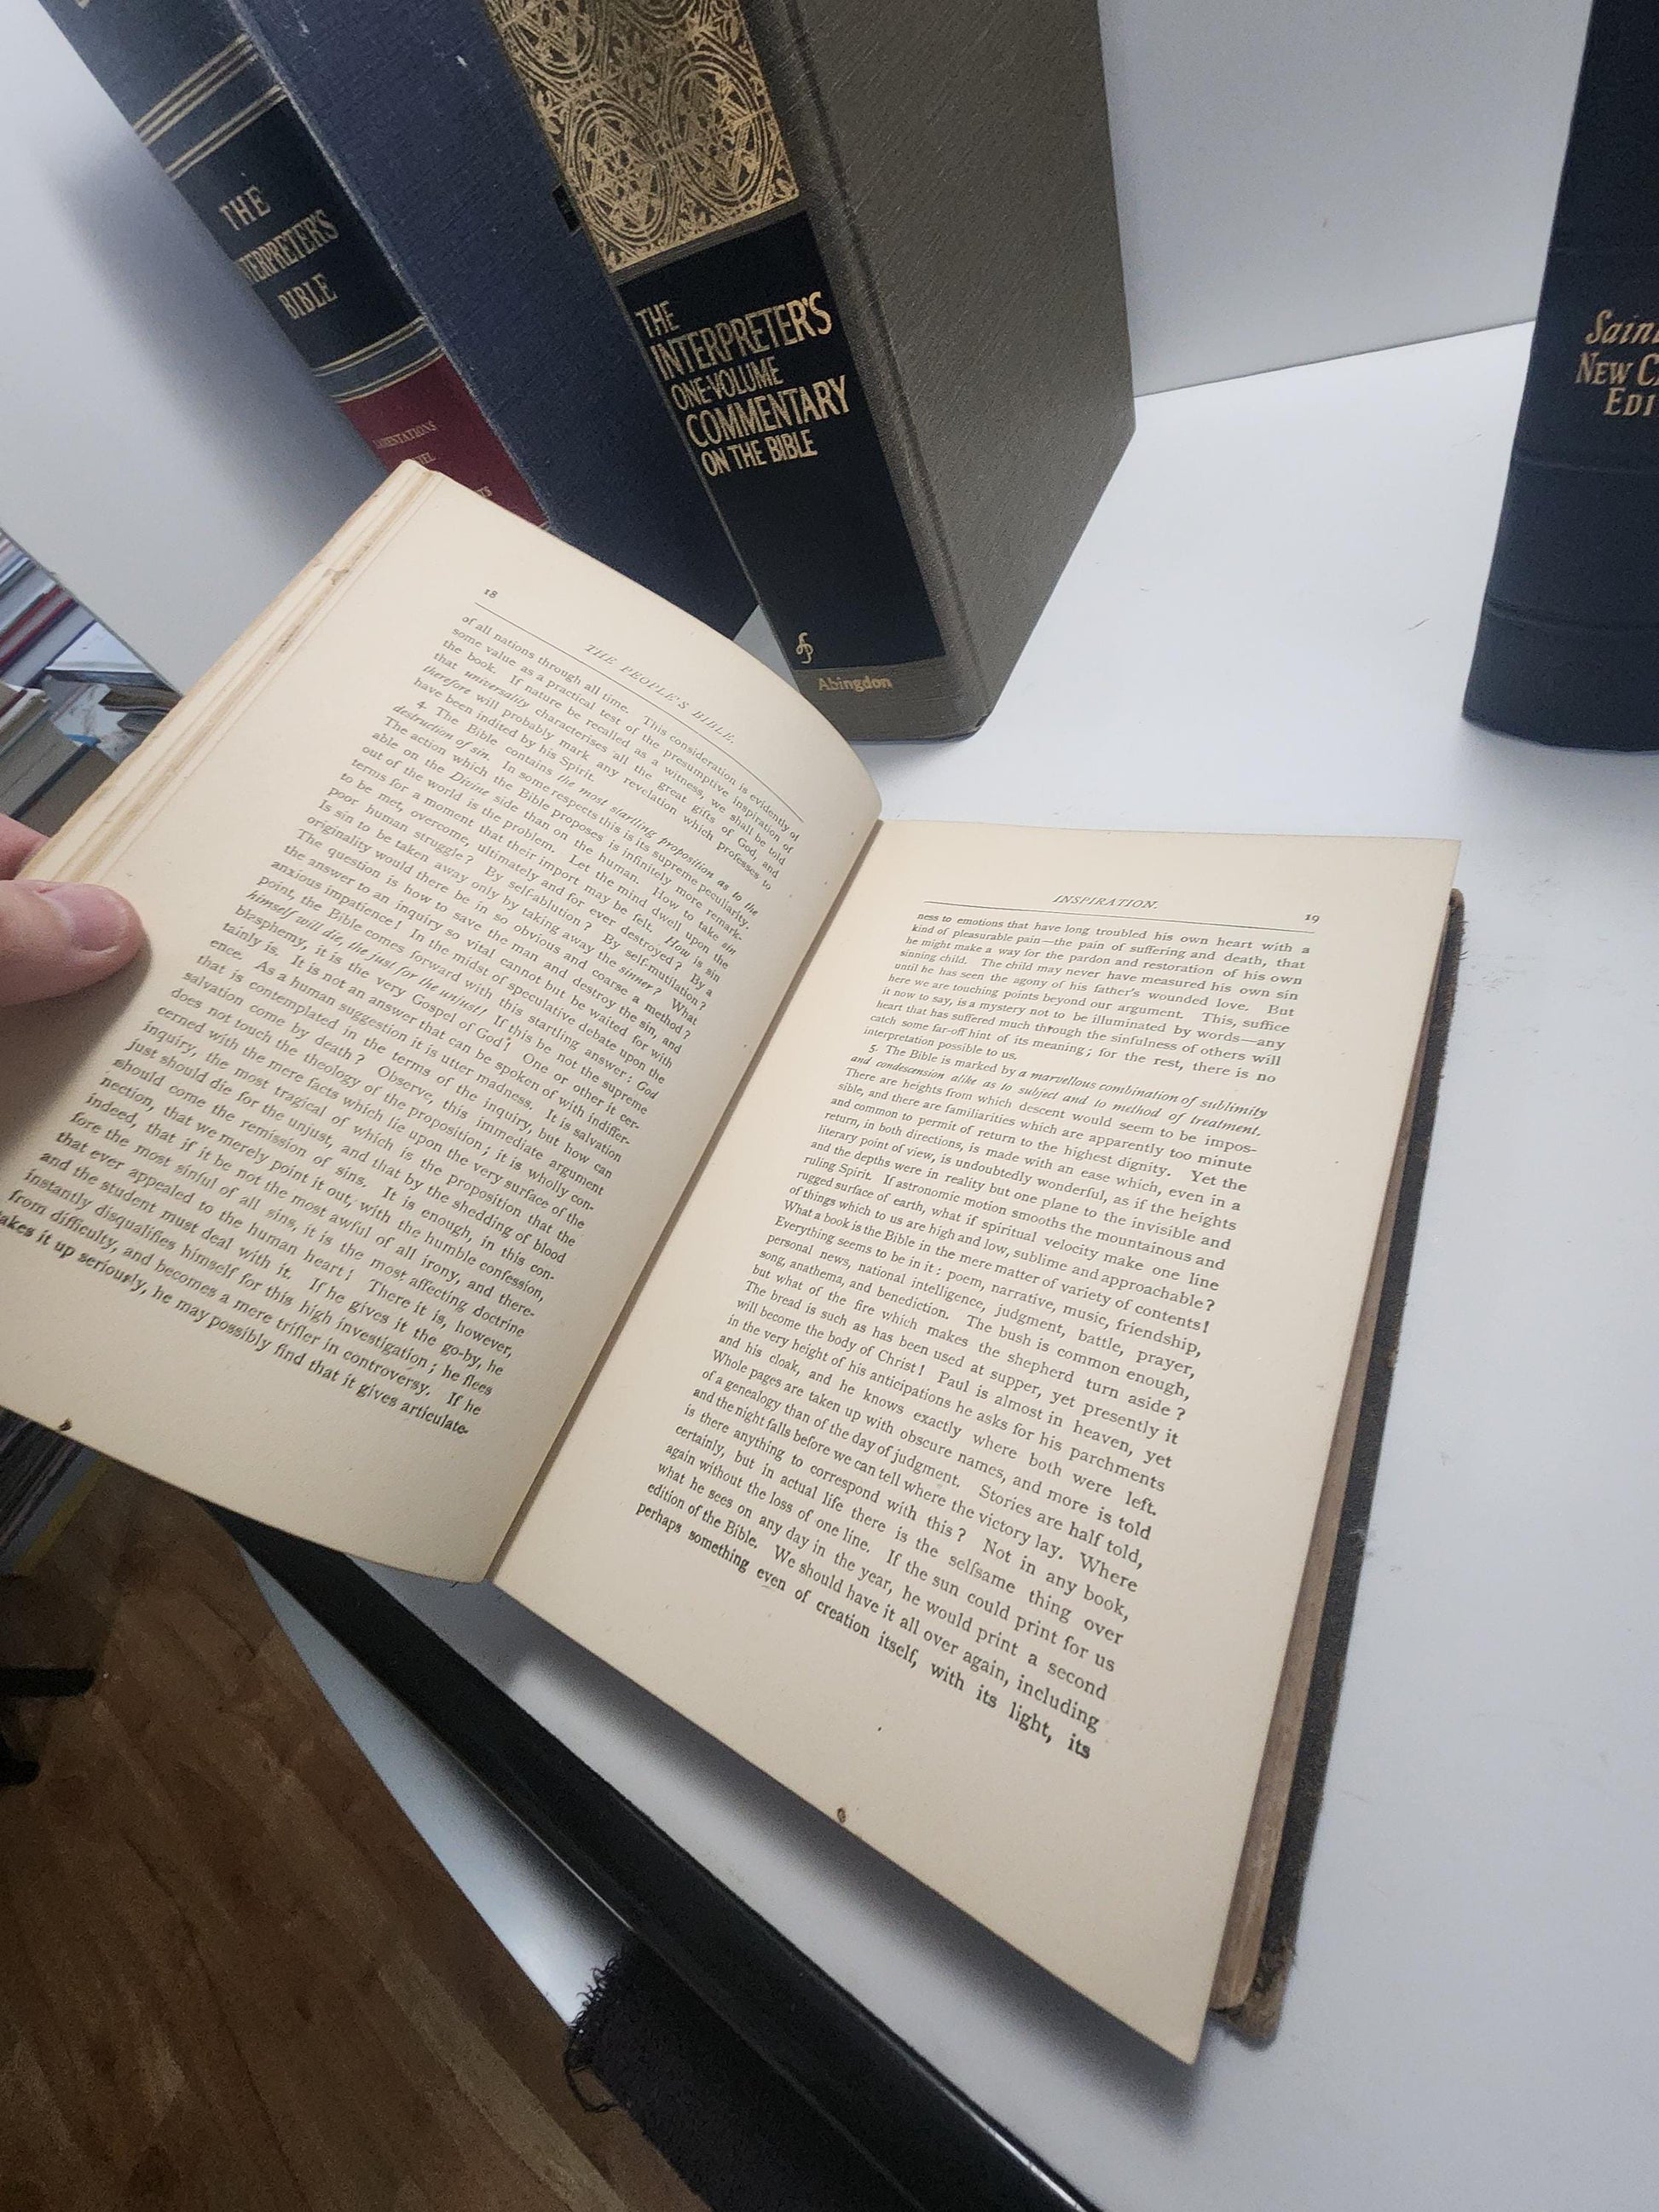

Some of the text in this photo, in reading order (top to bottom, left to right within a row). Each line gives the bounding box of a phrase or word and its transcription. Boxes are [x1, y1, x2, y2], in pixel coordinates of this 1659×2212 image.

[218, 185, 271, 230] THE
[234, 210, 339, 282] TERPRETER'S
[278, 273, 338, 320] BIBLE
[634, 300, 680, 338] THE
[650, 292, 833, 380] INTERPRETER'S
[670, 355, 784, 411] ONE-VOLUME
[1638, 353, 1659, 386] C
[685, 374, 850, 448] COMMENTARY
[1604, 387, 1656, 416] EDI
[701, 429, 818, 477] ON THE BIBLE
[483, 588, 499, 599] 18
[584, 644, 617, 665] THE
[619, 666, 690, 710] PEOPLE'S
[818, 675, 893, 692] Abingdon
[452, 628, 482, 648] some
[487, 646, 516, 667] value
[520, 667, 534, 676] as
[545, 680, 596, 710] practical
[600, 709, 621, 725] test
[626, 725, 640, 735] of
[642, 734, 660, 748] the
[662, 749, 729, 797] presumptive
[732, 796, 780, 842] inspiration
[783, 844, 794, 853] of
[297, 829, 322, 848] The
[327, 848, 381, 878] question
[385, 875, 398, 887] is
[403, 883, 432, 903] how
[435, 902, 448, 912] to
[453, 912, 482, 931] save
[487, 929, 508, 944] the
[511, 943, 539, 962] man
[543, 962, 569, 979] and
[572, 977, 617, 1009] destroy
[619, 1006, 638, 1022] the
[662, 1037, 682, 1054] and
[957, 918, 1003, 927] emotions
[1007, 921, 1028, 929] that
[1033, 921, 1061, 932] have
[1064, 924, 1090, 936] long
[1096, 928, 1147, 939] troubled
[1153, 932, 1173, 941] his
[1180, 936, 1208, 944] own
[1216, 937, 1252, 949] heart
[1262, 942, 1292, 952] with
[1304, 914, 1320, 924] 19
[905, 936, 918, 944] he
[921, 939, 951, 950] might
[954, 944, 983, 952] make
[999, 949, 1020, 958] way
[1024, 949, 1041, 957] for
[1045, 950, 1064, 960] the
[1068, 955, 1110, 964] pardon
[1114, 958, 1139, 967] and
[1142, 962, 1214, 975] restoration
[1223, 968, 1240, 978] of
[1243, 970, 1265, 981] his
[1270, 975, 1302, 985] own
[765, 1234, 814, 1255] personal
[858, 1263, 906, 1285] national
[8, 1189, 48, 1216] from
[121, 1247, 155, 1266] and
[153, 1258, 218, 1297] becomes
[218, 1294, 230, 1304] a
[232, 1299, 273, 1324] mere
[275, 1318, 321, 1345] trifler
[321, 1337, 339, 1355] in
[446, 1391, 465, 1407] If
[463, 1398, 482, 1415] he
[849, 1280, 873, 1293] and
[967, 1314, 992, 1333] The
[998, 1325, 1032, 1346] bush
[1036, 1337, 1049, 1352] is
[1057, 1349, 1120, 1376] common
[745, 1280, 766, 1297] The
[770, 1290, 803, 1310] bread
[805, 1302, 817, 1315] is
[820, 1311, 847, 1326] such
[853, 1323, 867, 1333] as
[871, 1325, 893, 1343] has
[899, 1335, 928, 1355] been
[934, 1350, 965, 1367] used
[970, 1364, 985, 1376] at
[1049, 1391, 1076, 1407] yet
[1081, 1403, 1160, 1440] presently
[1165, 1428, 1178, 1445] it
[734, 1449, 755, 1470] but
[761, 1463, 774, 1479] in
[780, 1476, 818, 1499] actual
[821, 1491, 843, 1512] life
[851, 1506, 886, 1533] there
[894, 1526, 908, 1543] is
[915, 1537, 939, 1557] the
[948, 1556, 1015, 1594] selfsame
[1029, 1590, 1072, 1624] thing
[1084, 1619, 1124, 1645] over
[658, 1463, 685, 1485] what
[689, 1476, 705, 1494] he
[708, 1489, 733, 1509] sees
[737, 1505, 753, 1519] on
[759, 1516, 783, 1536] any
[785, 1527, 810, 1550] day
[812, 1539, 826, 1557] in
[834, 1551, 855, 1572] the
[902, 1585, 921, 1606] he
[927, 1600, 974, 1632] would
[974, 1627, 1019, 1656] print
[1027, 1653, 1038, 1666] a
[1047, 1662, 1108, 1701] second
[635, 1503, 682, 1533] perhaps
[688, 1530, 750, 1574] something
[756, 1568, 786, 1591] even
[795, 1589, 812, 1603] of
[816, 1601, 870, 1638] creation
[931, 1663, 964, 1691] with
[975, 1684, 997, 1708] its
[1067, 1732, 1090, 1759] its
